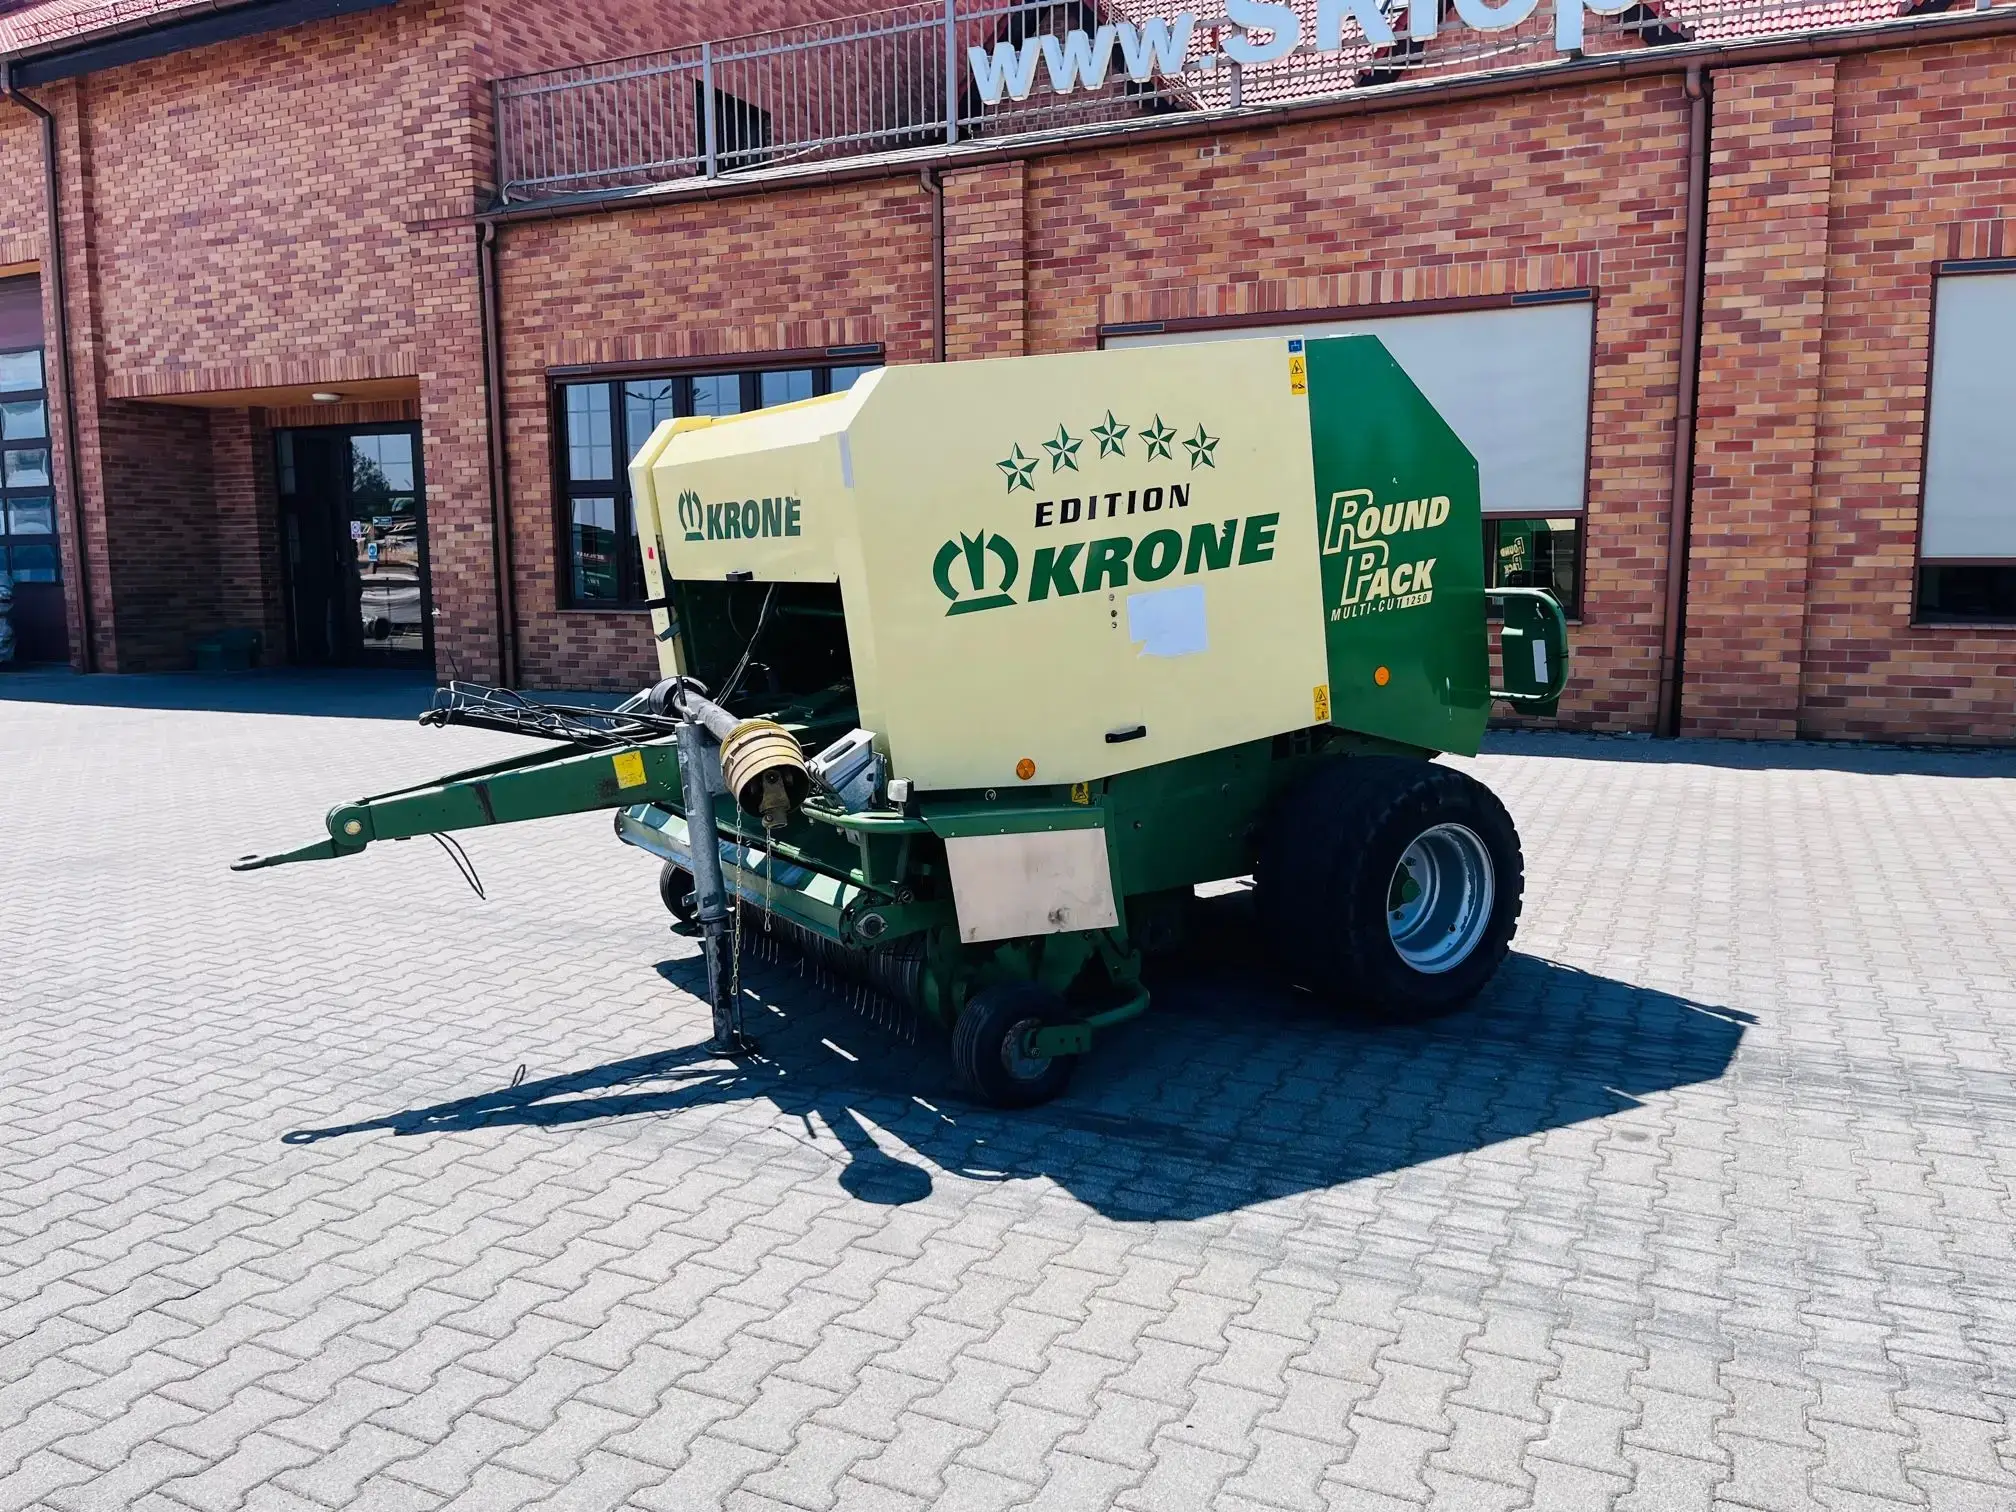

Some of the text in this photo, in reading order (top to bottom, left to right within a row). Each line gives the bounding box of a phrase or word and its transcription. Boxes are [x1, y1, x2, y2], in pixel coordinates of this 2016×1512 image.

[706, 497, 801, 541] KRONE
[1034, 483, 1191, 528] EDITION
[1322, 488, 1450, 555] ROUND
[1027, 512, 1280, 603] KRONE
[1340, 540, 1437, 606] PACK
[1330, 593, 1429, 622] MULTI-CUT 1250
